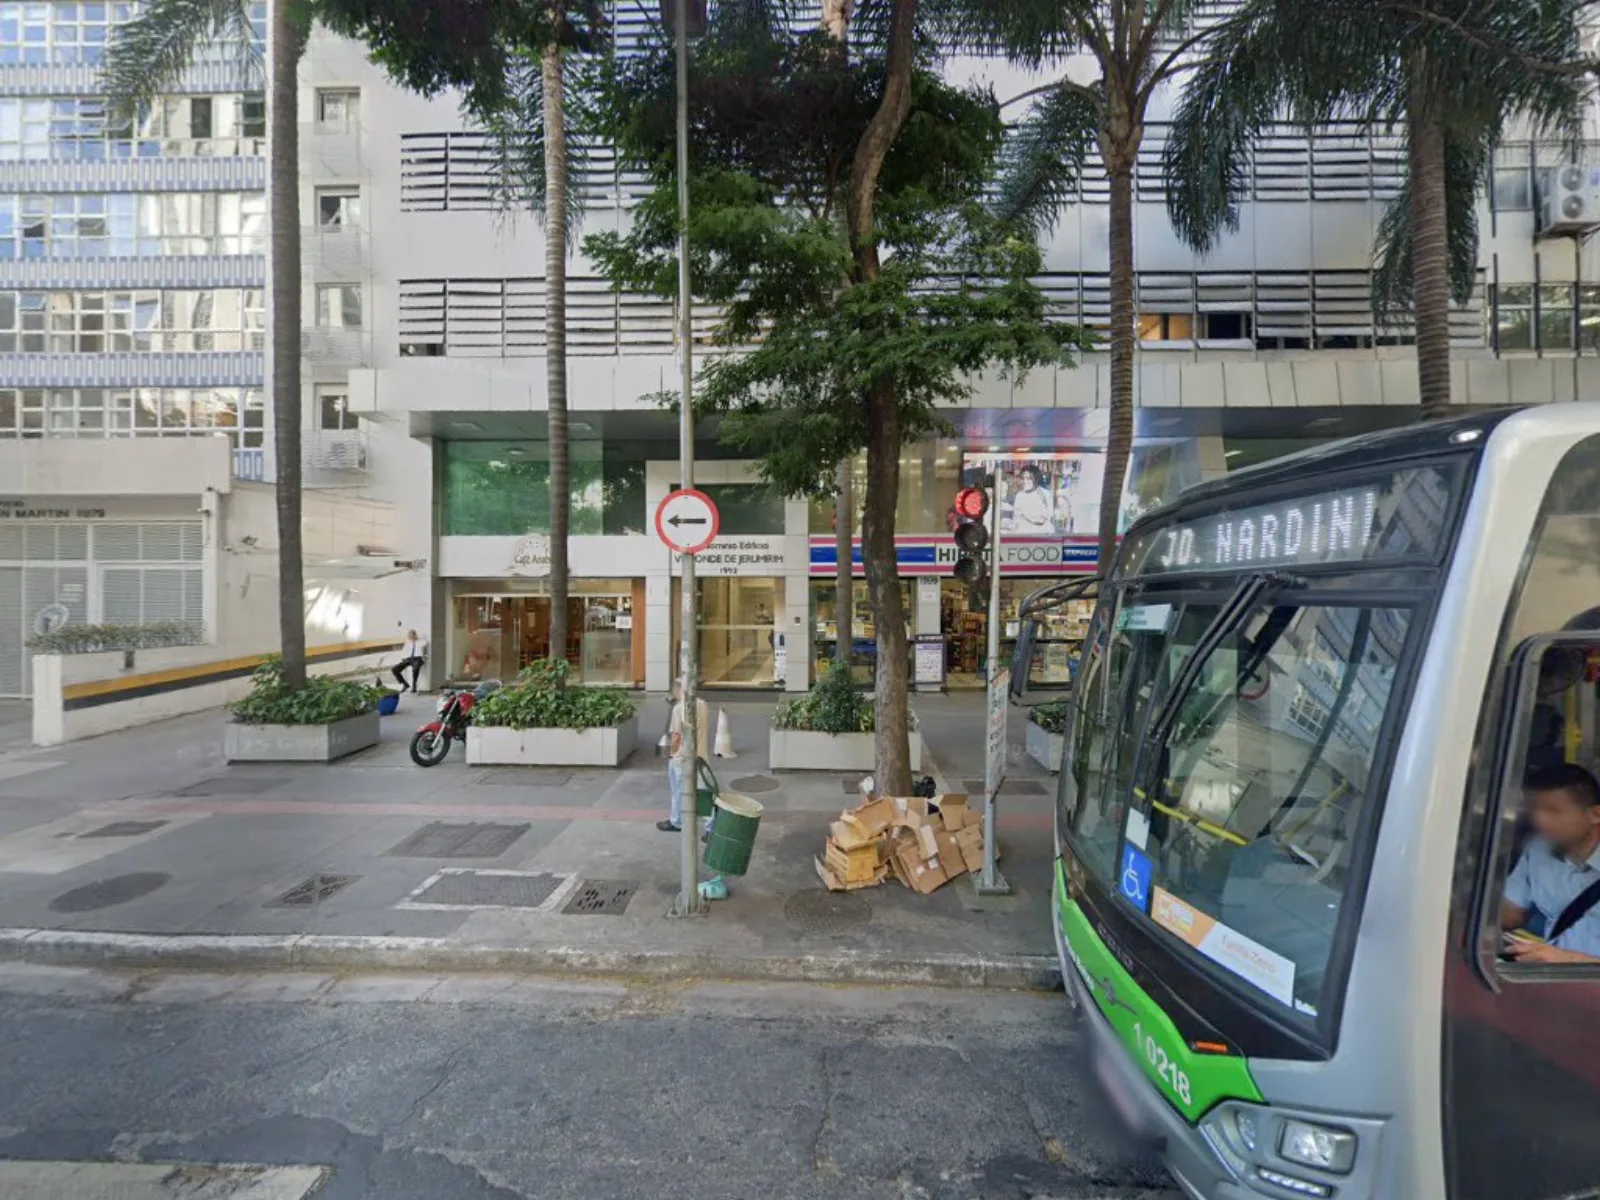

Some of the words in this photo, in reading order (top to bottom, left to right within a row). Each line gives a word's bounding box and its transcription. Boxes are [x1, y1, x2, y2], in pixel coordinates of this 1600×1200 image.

[15, 508, 70, 518] MARTIN
[1161, 528, 1201, 567] JD.
[1216, 492, 1375, 563] NARDINI
[724, 554, 738, 563] DE
[1007, 547, 1060, 562] FOOD
